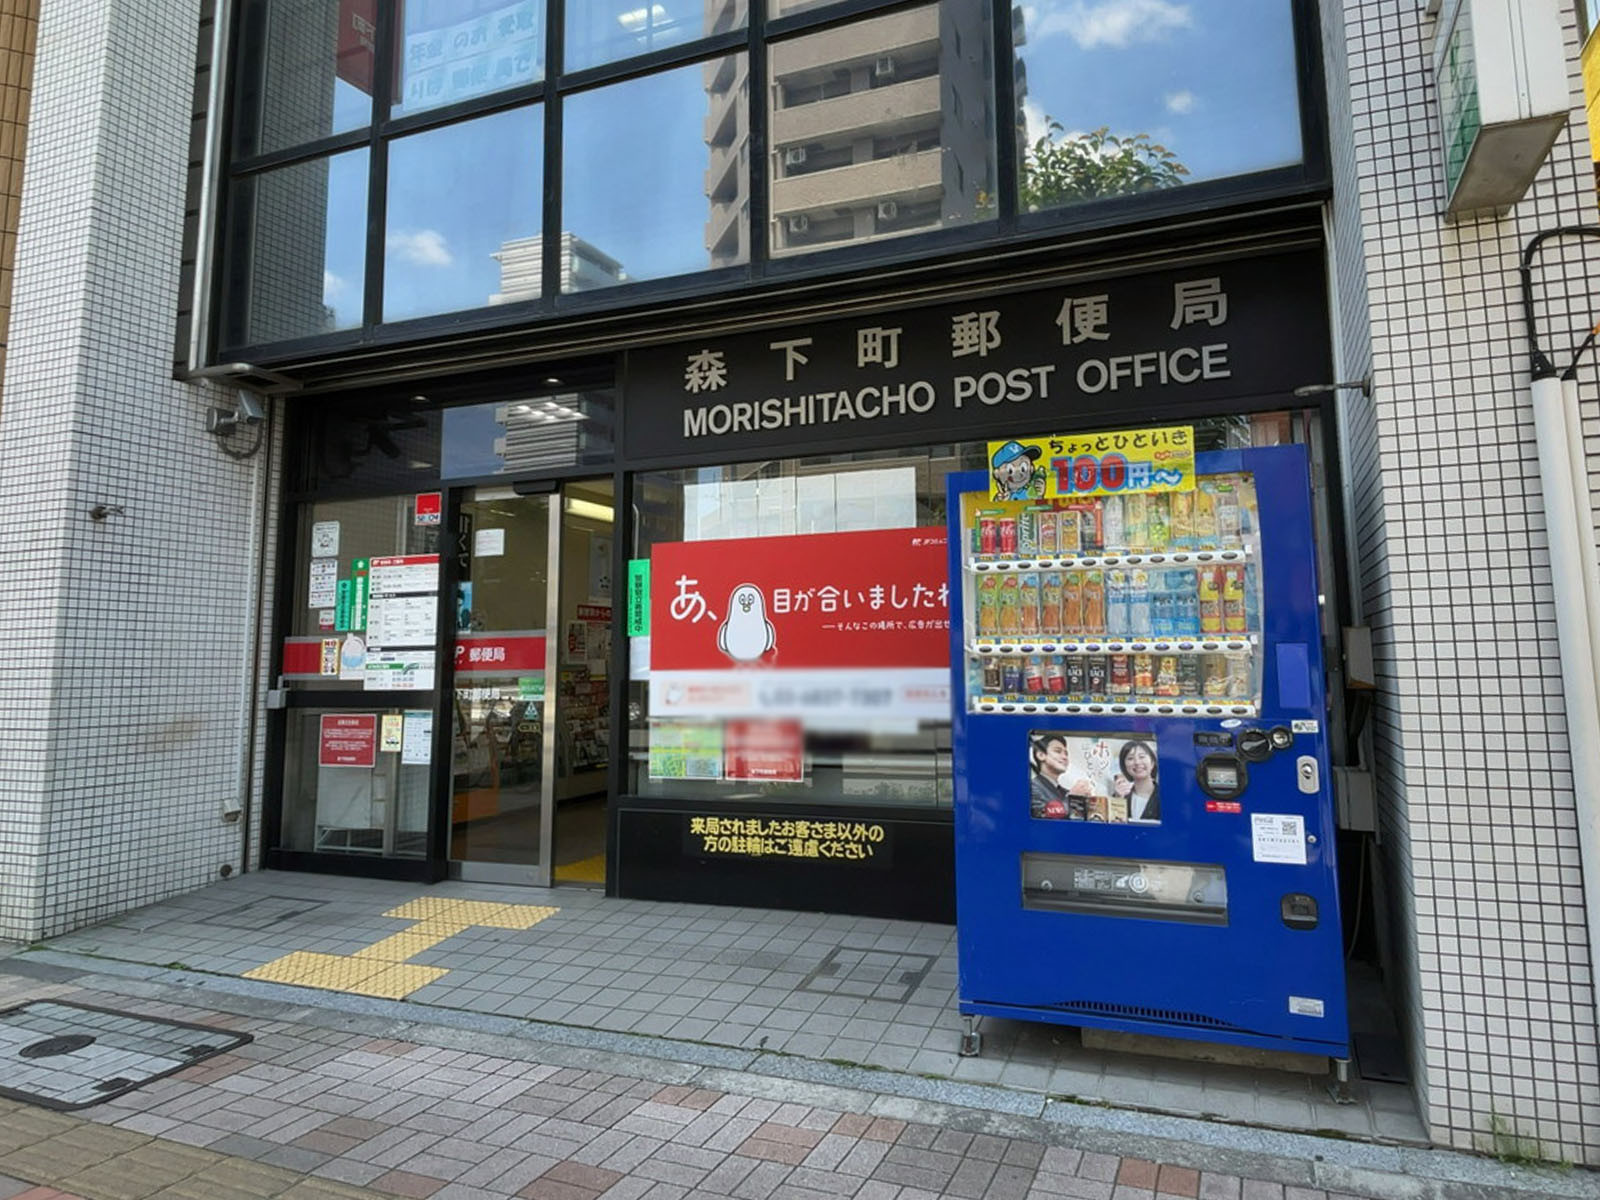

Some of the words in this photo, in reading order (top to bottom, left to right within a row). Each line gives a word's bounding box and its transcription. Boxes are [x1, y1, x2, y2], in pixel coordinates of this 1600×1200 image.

[684, 277, 1229, 394] 森下町郵便局
[683, 380, 936, 438] MORISHITACHO
[954, 364, 1056, 409] POST
[1076, 343, 1231, 394] OFFICE
[1048, 430, 1188, 455] ちょっとひといき
[669, 574, 718, 624] あ、
[469, 646, 506, 662] 郵便局
[690, 816, 885, 843] 来局されましたお客さま以外の
[703, 835, 873, 860] 方の駐輪はご遠慮ください
